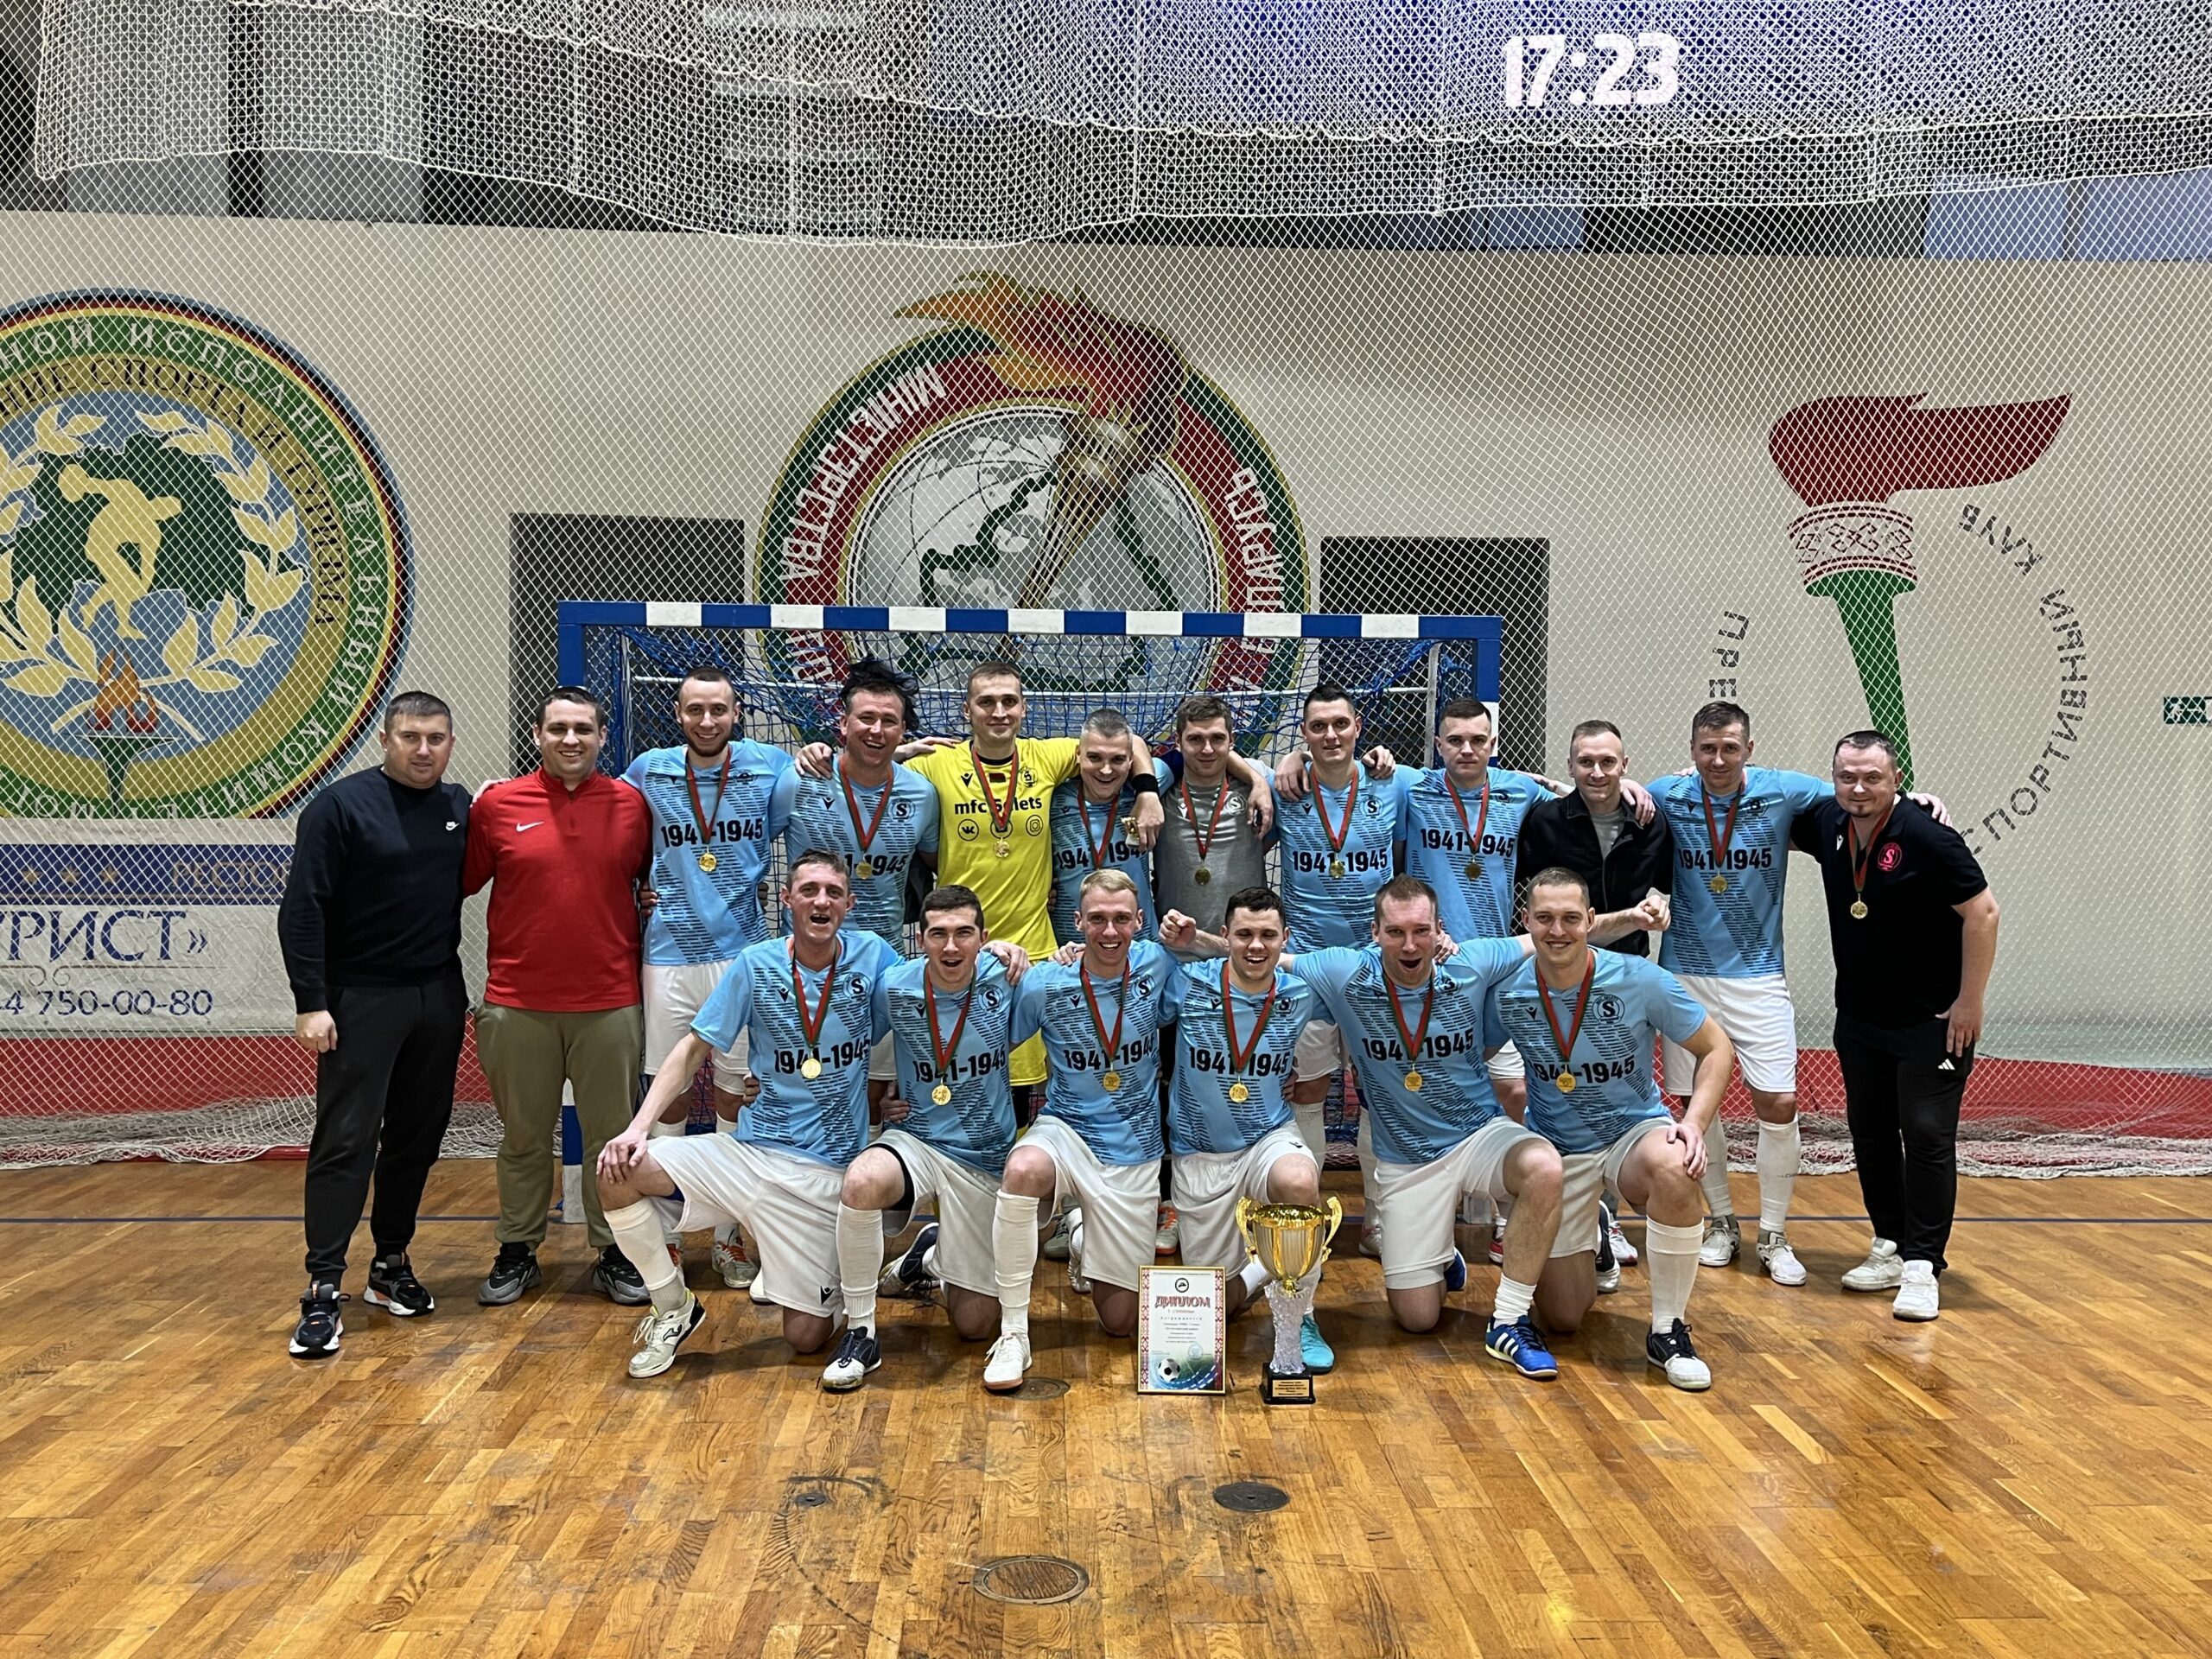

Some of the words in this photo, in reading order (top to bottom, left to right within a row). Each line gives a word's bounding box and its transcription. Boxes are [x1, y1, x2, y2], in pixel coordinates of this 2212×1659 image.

[1503, 32, 1680, 108] 17:23
[90, 357, 245, 429] СПОРТА
[1958, 503, 2043, 576] КЛУБ
[1225, 467, 1286, 654] БЛАРУСЬ
[955, 798, 987, 815] mfc
[993, 796, 1043, 813] Slets
[660, 818, 764, 847] 194-1945
[1421, 829, 1515, 857] 1941-945
[1678, 848, 1772, 870] 19411945
[0, 910, 208, 963] РИСТ»
[0, 990, 24, 1015] 4
[37, 989, 213, 1016] 750-00-80
[1362, 1028, 1474, 1062] 1941945
[1189, 1046, 1291, 1077] 19411945
[1154, 1295, 1211, 1309] ДИПЛОМ
